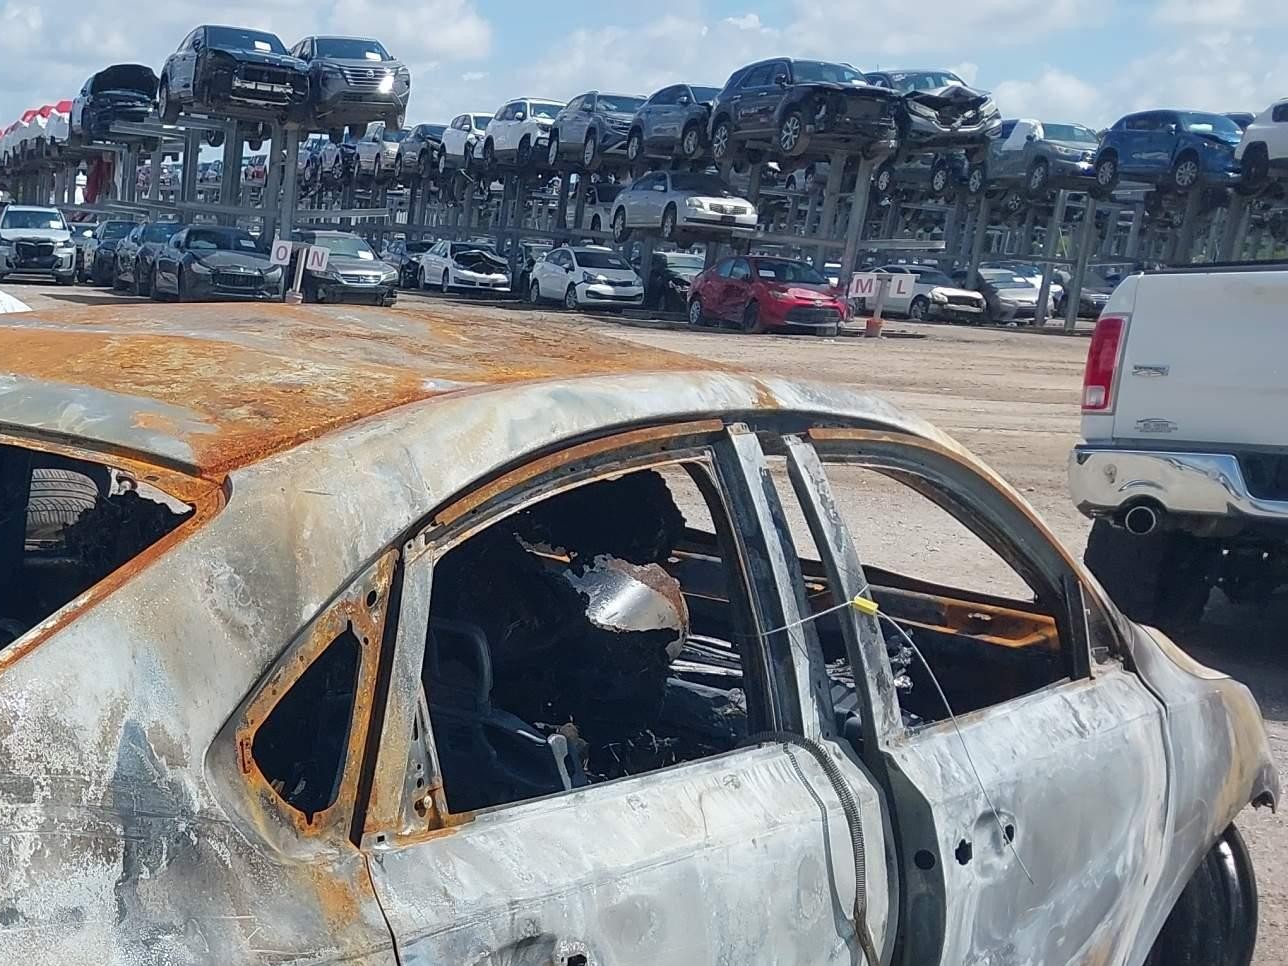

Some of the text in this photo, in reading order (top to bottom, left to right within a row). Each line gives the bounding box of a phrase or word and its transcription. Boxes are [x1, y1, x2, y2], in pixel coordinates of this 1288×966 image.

[276, 245, 289, 261] O
[311, 250, 325, 267] N
[855, 278, 873, 294] M
[896, 279, 907, 295] L
